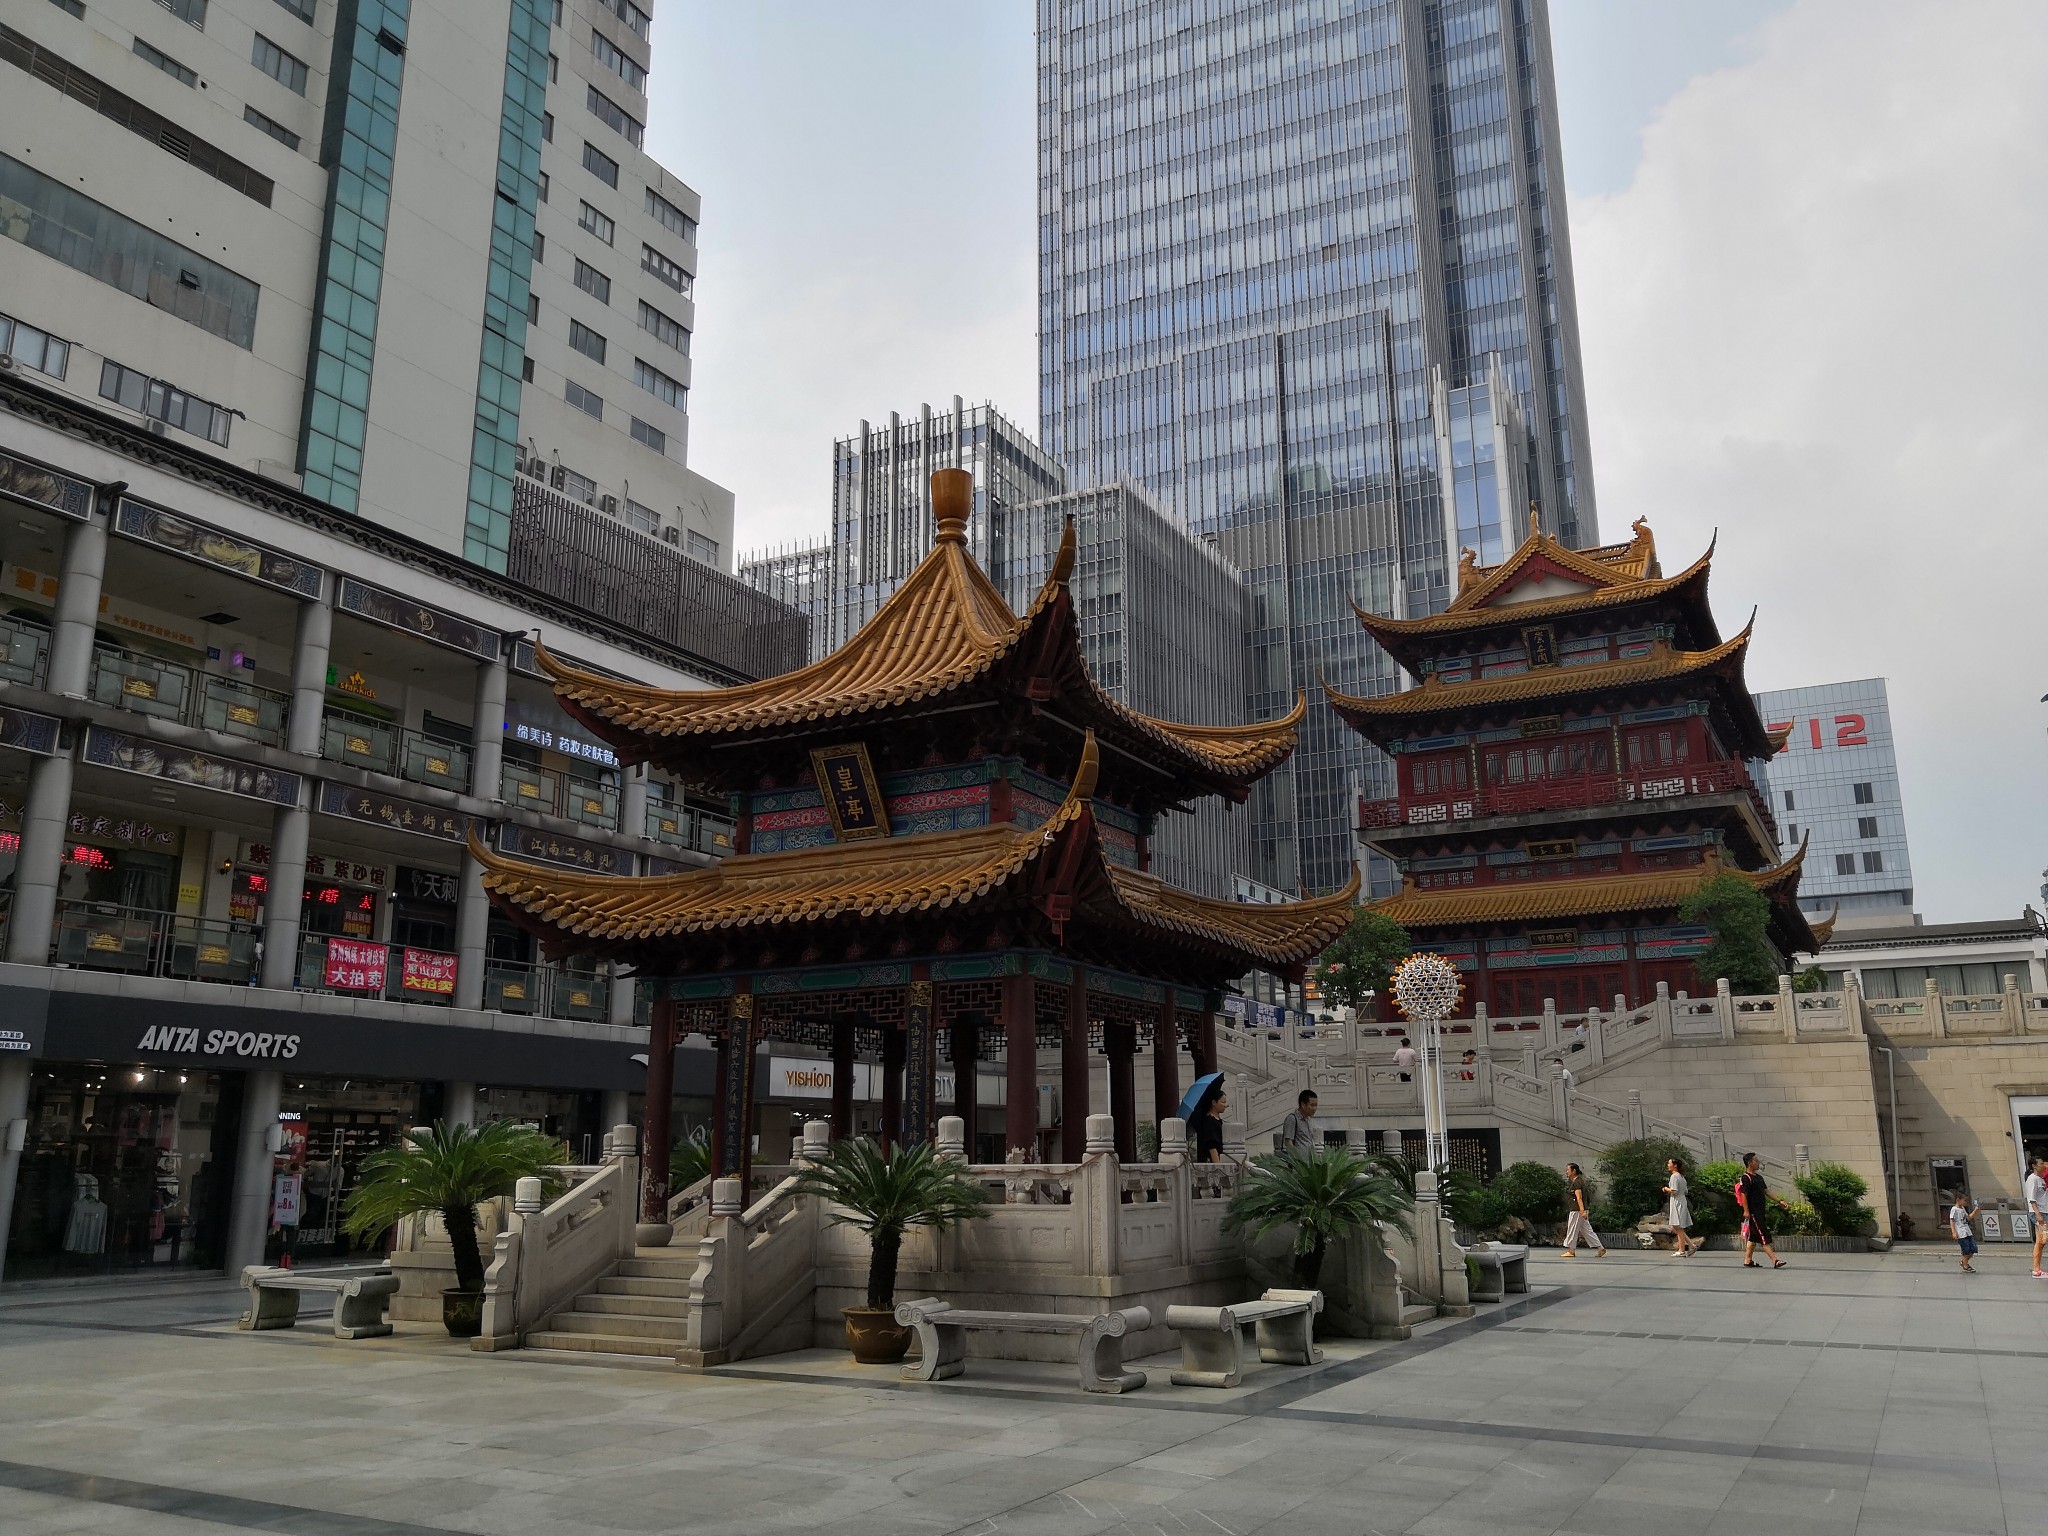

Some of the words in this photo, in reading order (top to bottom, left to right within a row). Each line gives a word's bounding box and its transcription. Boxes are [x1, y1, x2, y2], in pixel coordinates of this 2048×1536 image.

[357, 799, 455, 834] 无锡壹街区
[407, 951, 454, 968] 宜兴紫砂
[331, 966, 383, 988] 大拍卖
[405, 975, 454, 992] 大拍卖
[136, 1024, 200, 1053] ANTA
[203, 1029, 301, 1058] SPORTS
